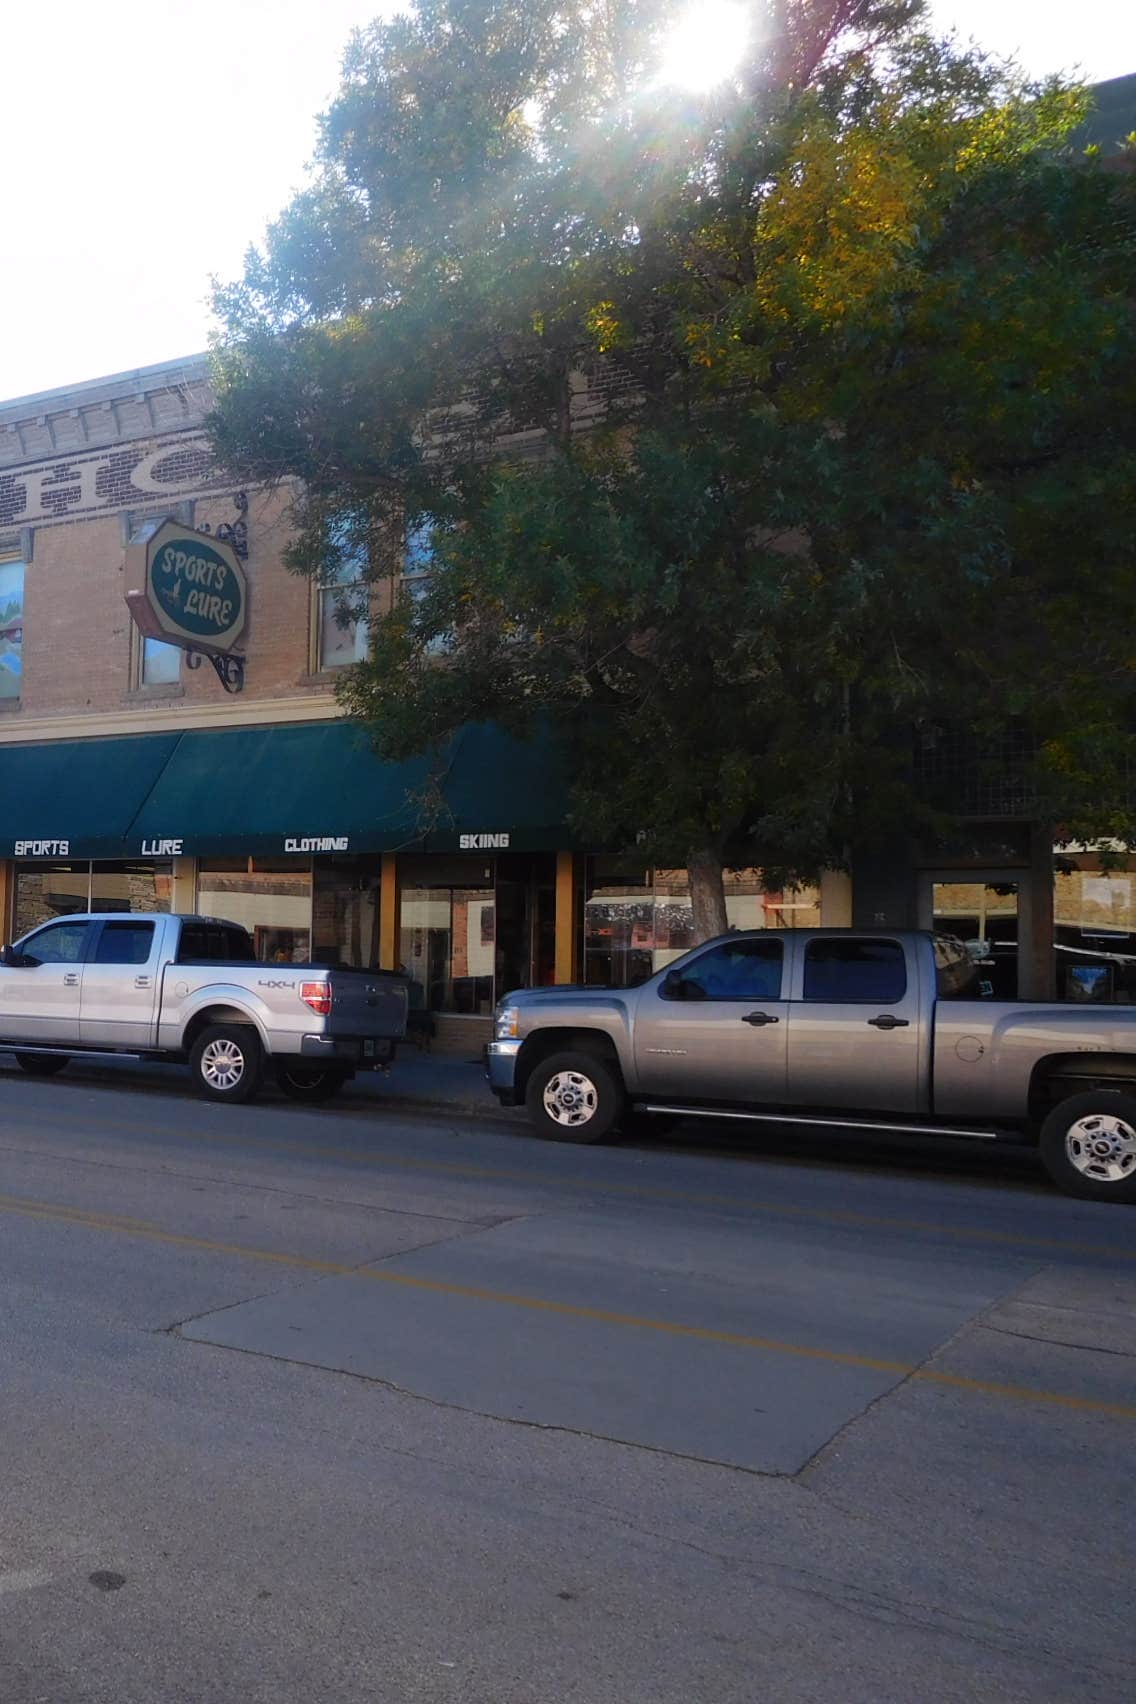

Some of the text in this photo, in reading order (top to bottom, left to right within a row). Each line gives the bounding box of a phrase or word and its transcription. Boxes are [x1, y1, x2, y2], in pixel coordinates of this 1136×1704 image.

[162, 546, 227, 591] SPORTS
[183, 589, 233, 627] LURE
[14, 839, 184, 856] SPORTS LURE
[284, 837, 349, 852] CLOTHING
[459, 833, 510, 849] SKIING
